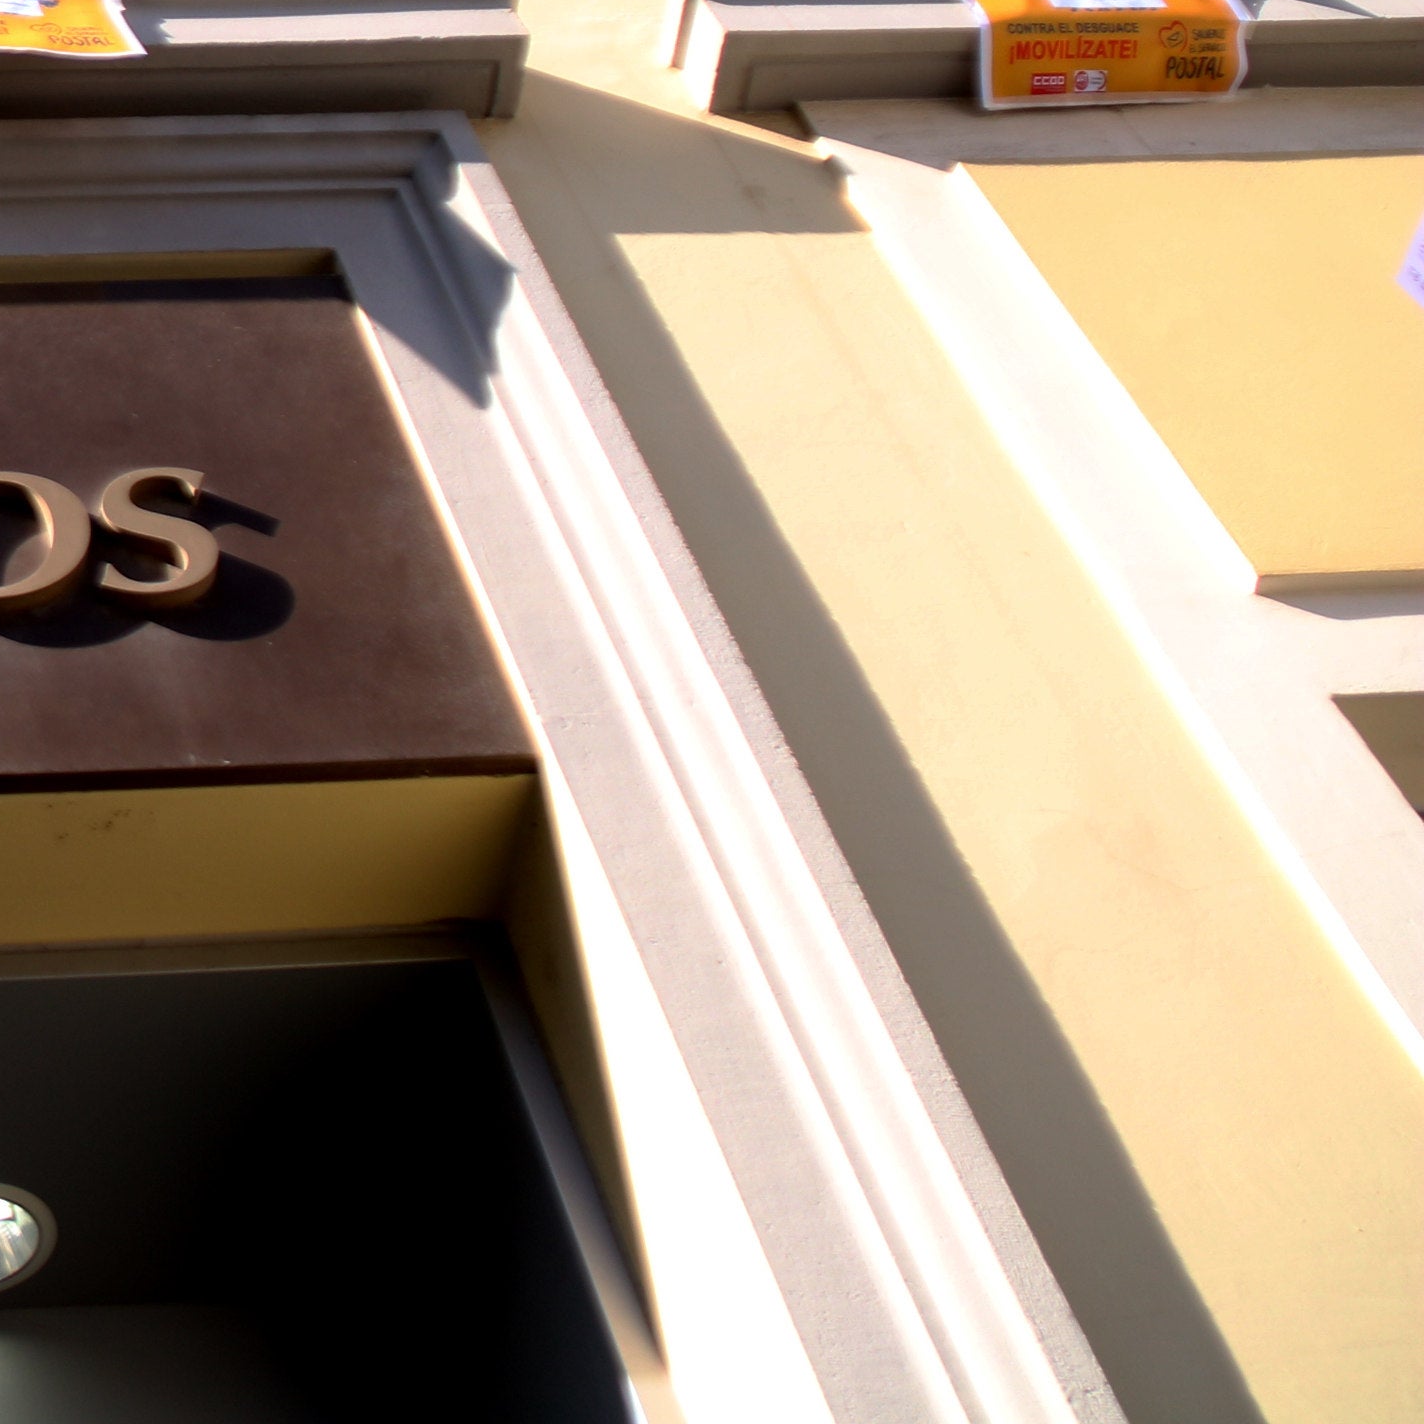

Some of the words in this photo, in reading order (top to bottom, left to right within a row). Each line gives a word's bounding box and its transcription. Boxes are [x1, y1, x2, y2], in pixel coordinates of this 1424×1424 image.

[1007, 22, 1056, 35] CONTRA
[1058, 22, 1074, 34] EL
[1076, 22, 1140, 34] DESGUACE
[48, 35, 115, 47] POSTAL
[1009, 35, 1139, 65] ¡MOVILÍZATE!
[1166, 55, 1225, 81] POSTAL
